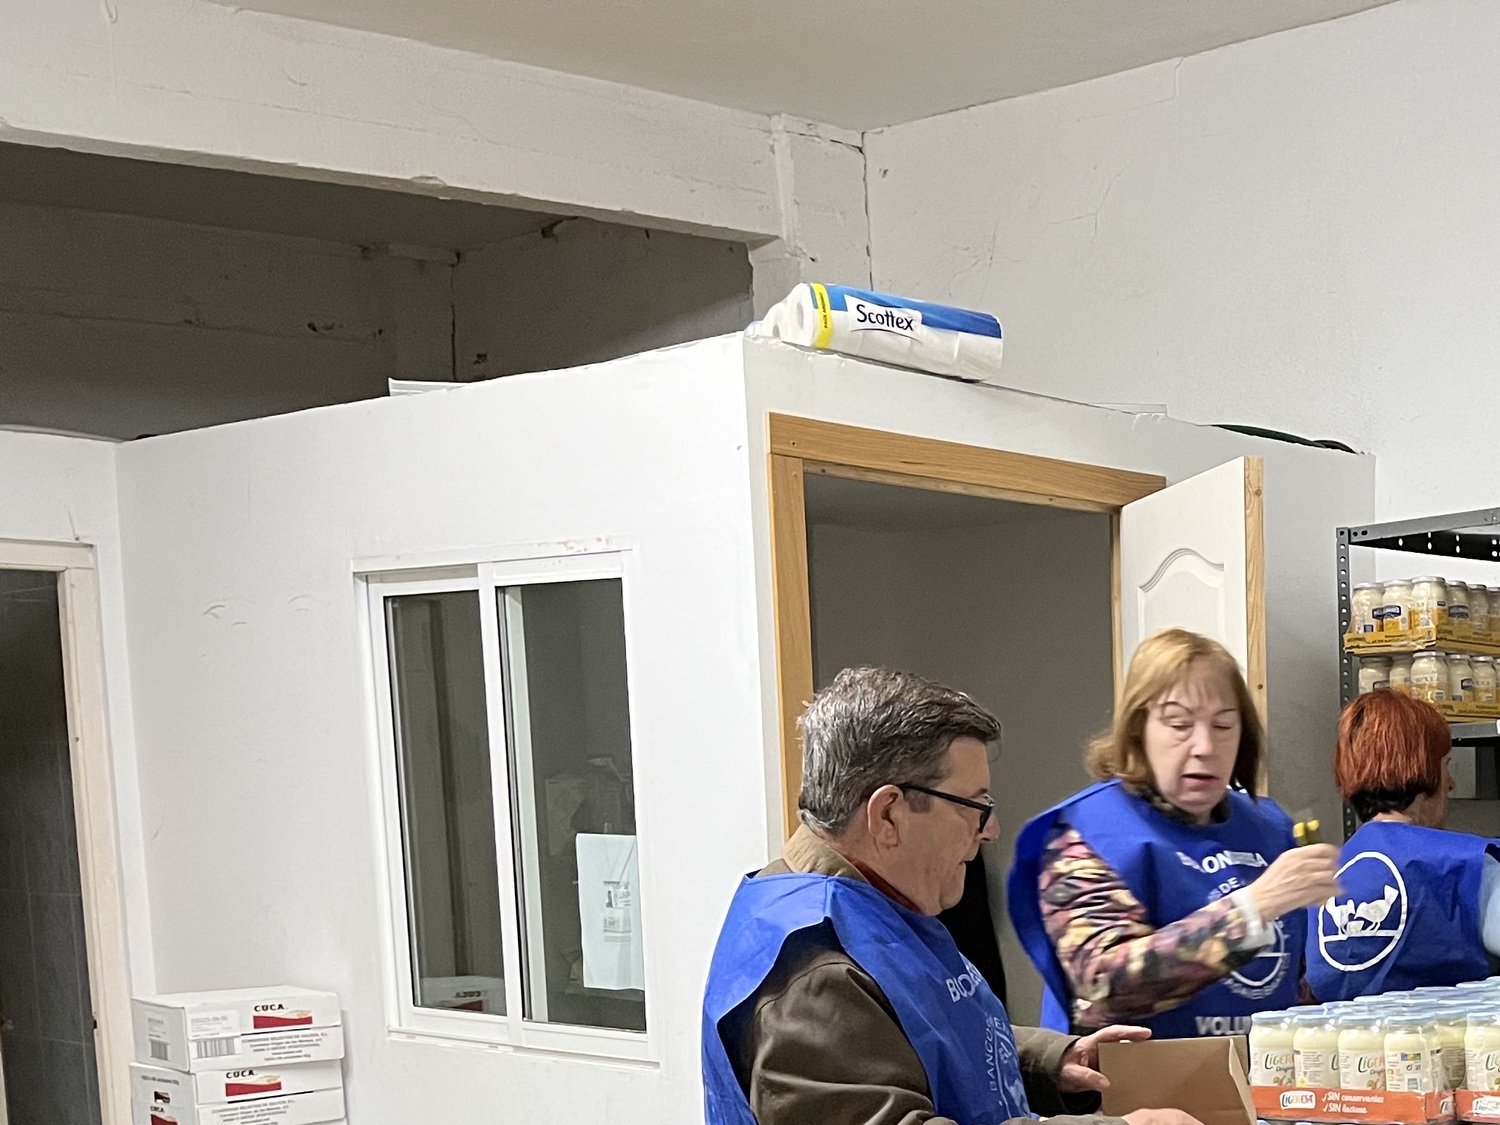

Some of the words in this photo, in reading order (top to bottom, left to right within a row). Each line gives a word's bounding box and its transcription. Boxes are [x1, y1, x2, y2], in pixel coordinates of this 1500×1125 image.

[856, 304, 914, 331] Scottex
[254, 1003, 285, 1012] CUCA
[226, 1069, 256, 1079] CUCA
[1327, 1092, 1340, 1101] SIN
[1328, 1104, 1341, 1112] SIN
[1342, 1105, 1367, 1114] lactosa
